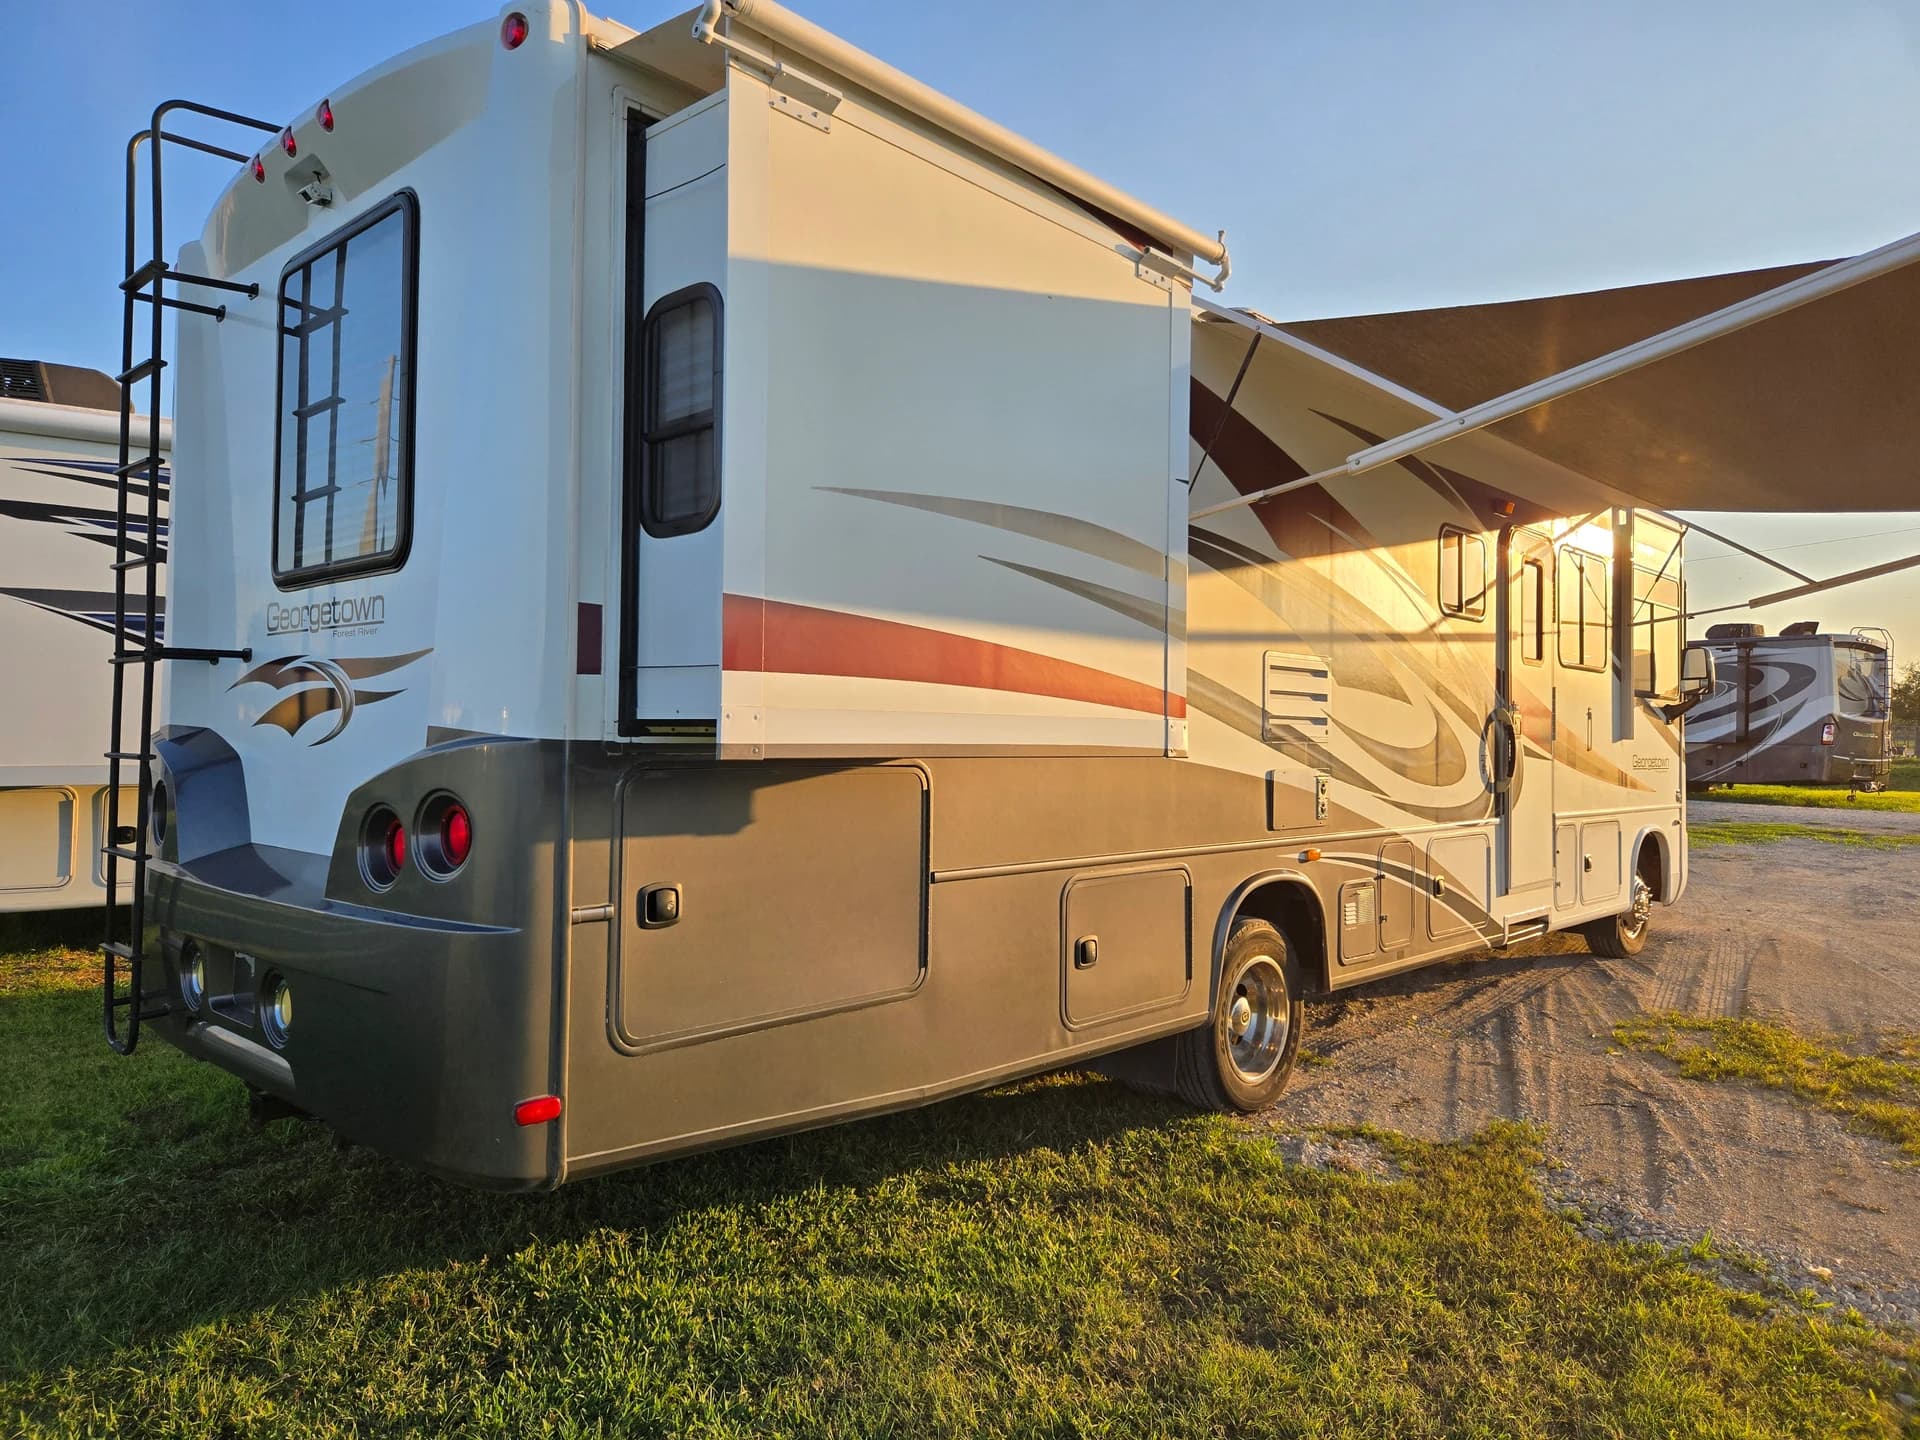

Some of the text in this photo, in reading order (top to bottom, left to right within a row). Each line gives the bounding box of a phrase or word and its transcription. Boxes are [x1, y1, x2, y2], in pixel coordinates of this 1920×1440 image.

[267, 595, 384, 633] Georgetown
[332, 627, 378, 638] Forest River
